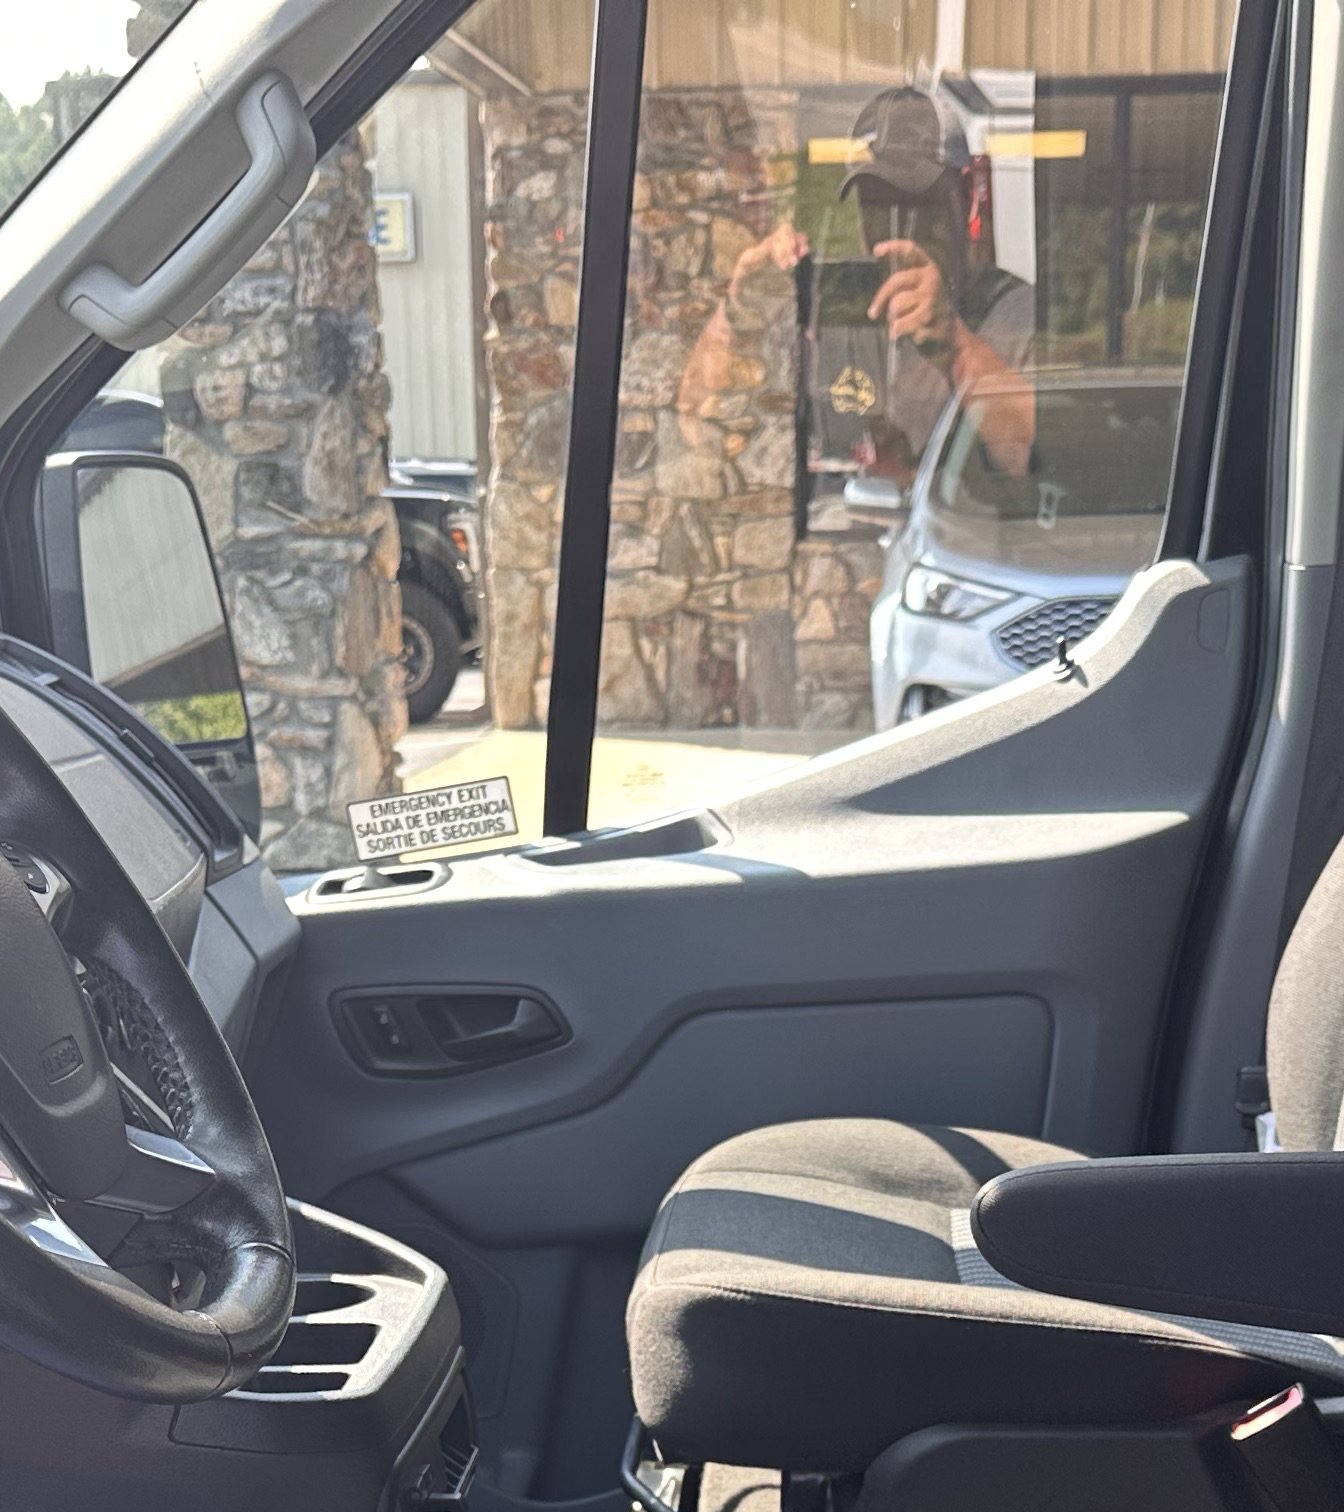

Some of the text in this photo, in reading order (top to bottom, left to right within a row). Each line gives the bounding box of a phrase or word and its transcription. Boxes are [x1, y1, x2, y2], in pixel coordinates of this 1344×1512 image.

[356, 799, 511, 838] SALIDA DE EMERGENCIA
[370, 784, 488, 818] EMERGENCY EXIT
[367, 817, 506, 853] SORTIE DE SECOURS
